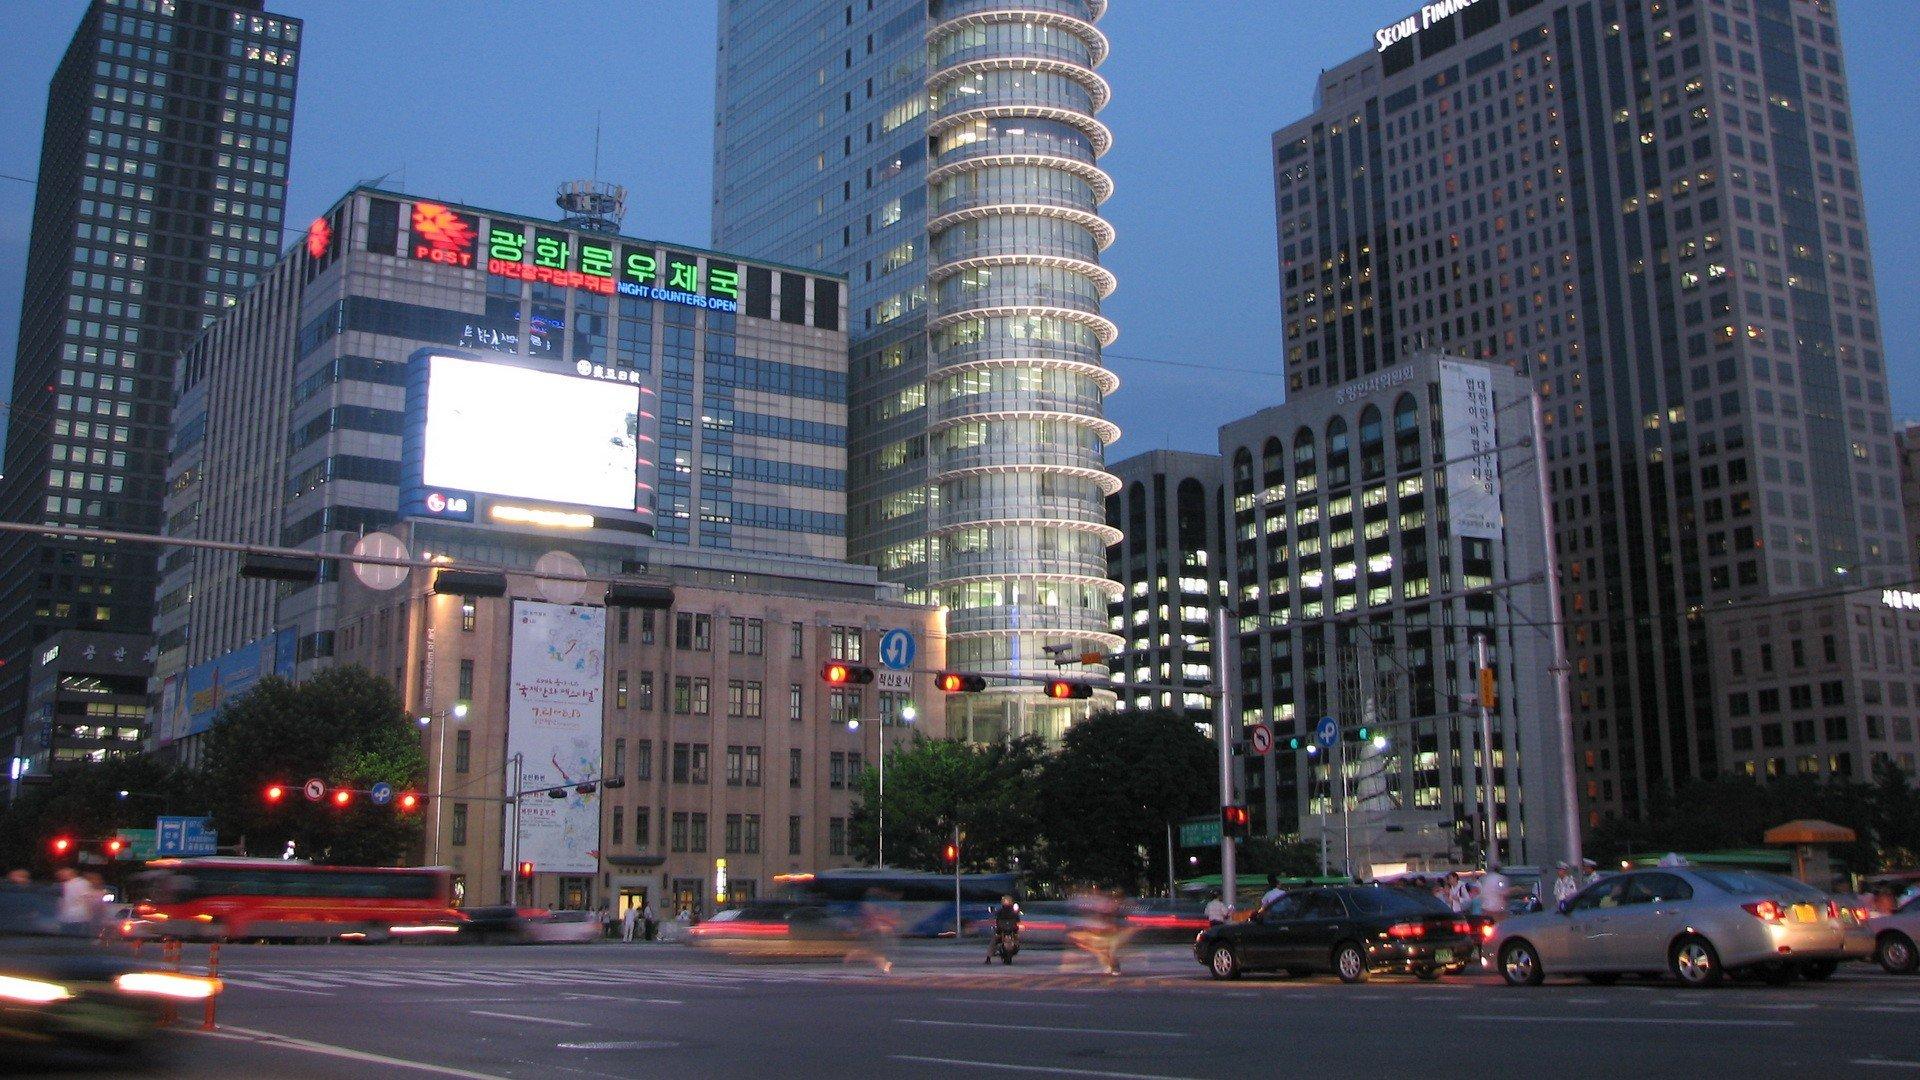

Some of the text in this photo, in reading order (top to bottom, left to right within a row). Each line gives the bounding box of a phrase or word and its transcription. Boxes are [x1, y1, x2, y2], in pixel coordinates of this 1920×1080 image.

[1376, 0, 1480, 53] SEOUL FINAN
[416, 246, 471, 266] POST
[489, 229, 739, 299] 광화문우체국
[617, 280, 738, 312] NIGHT COUNTERS OPEN
[447, 497, 468, 512] LG
